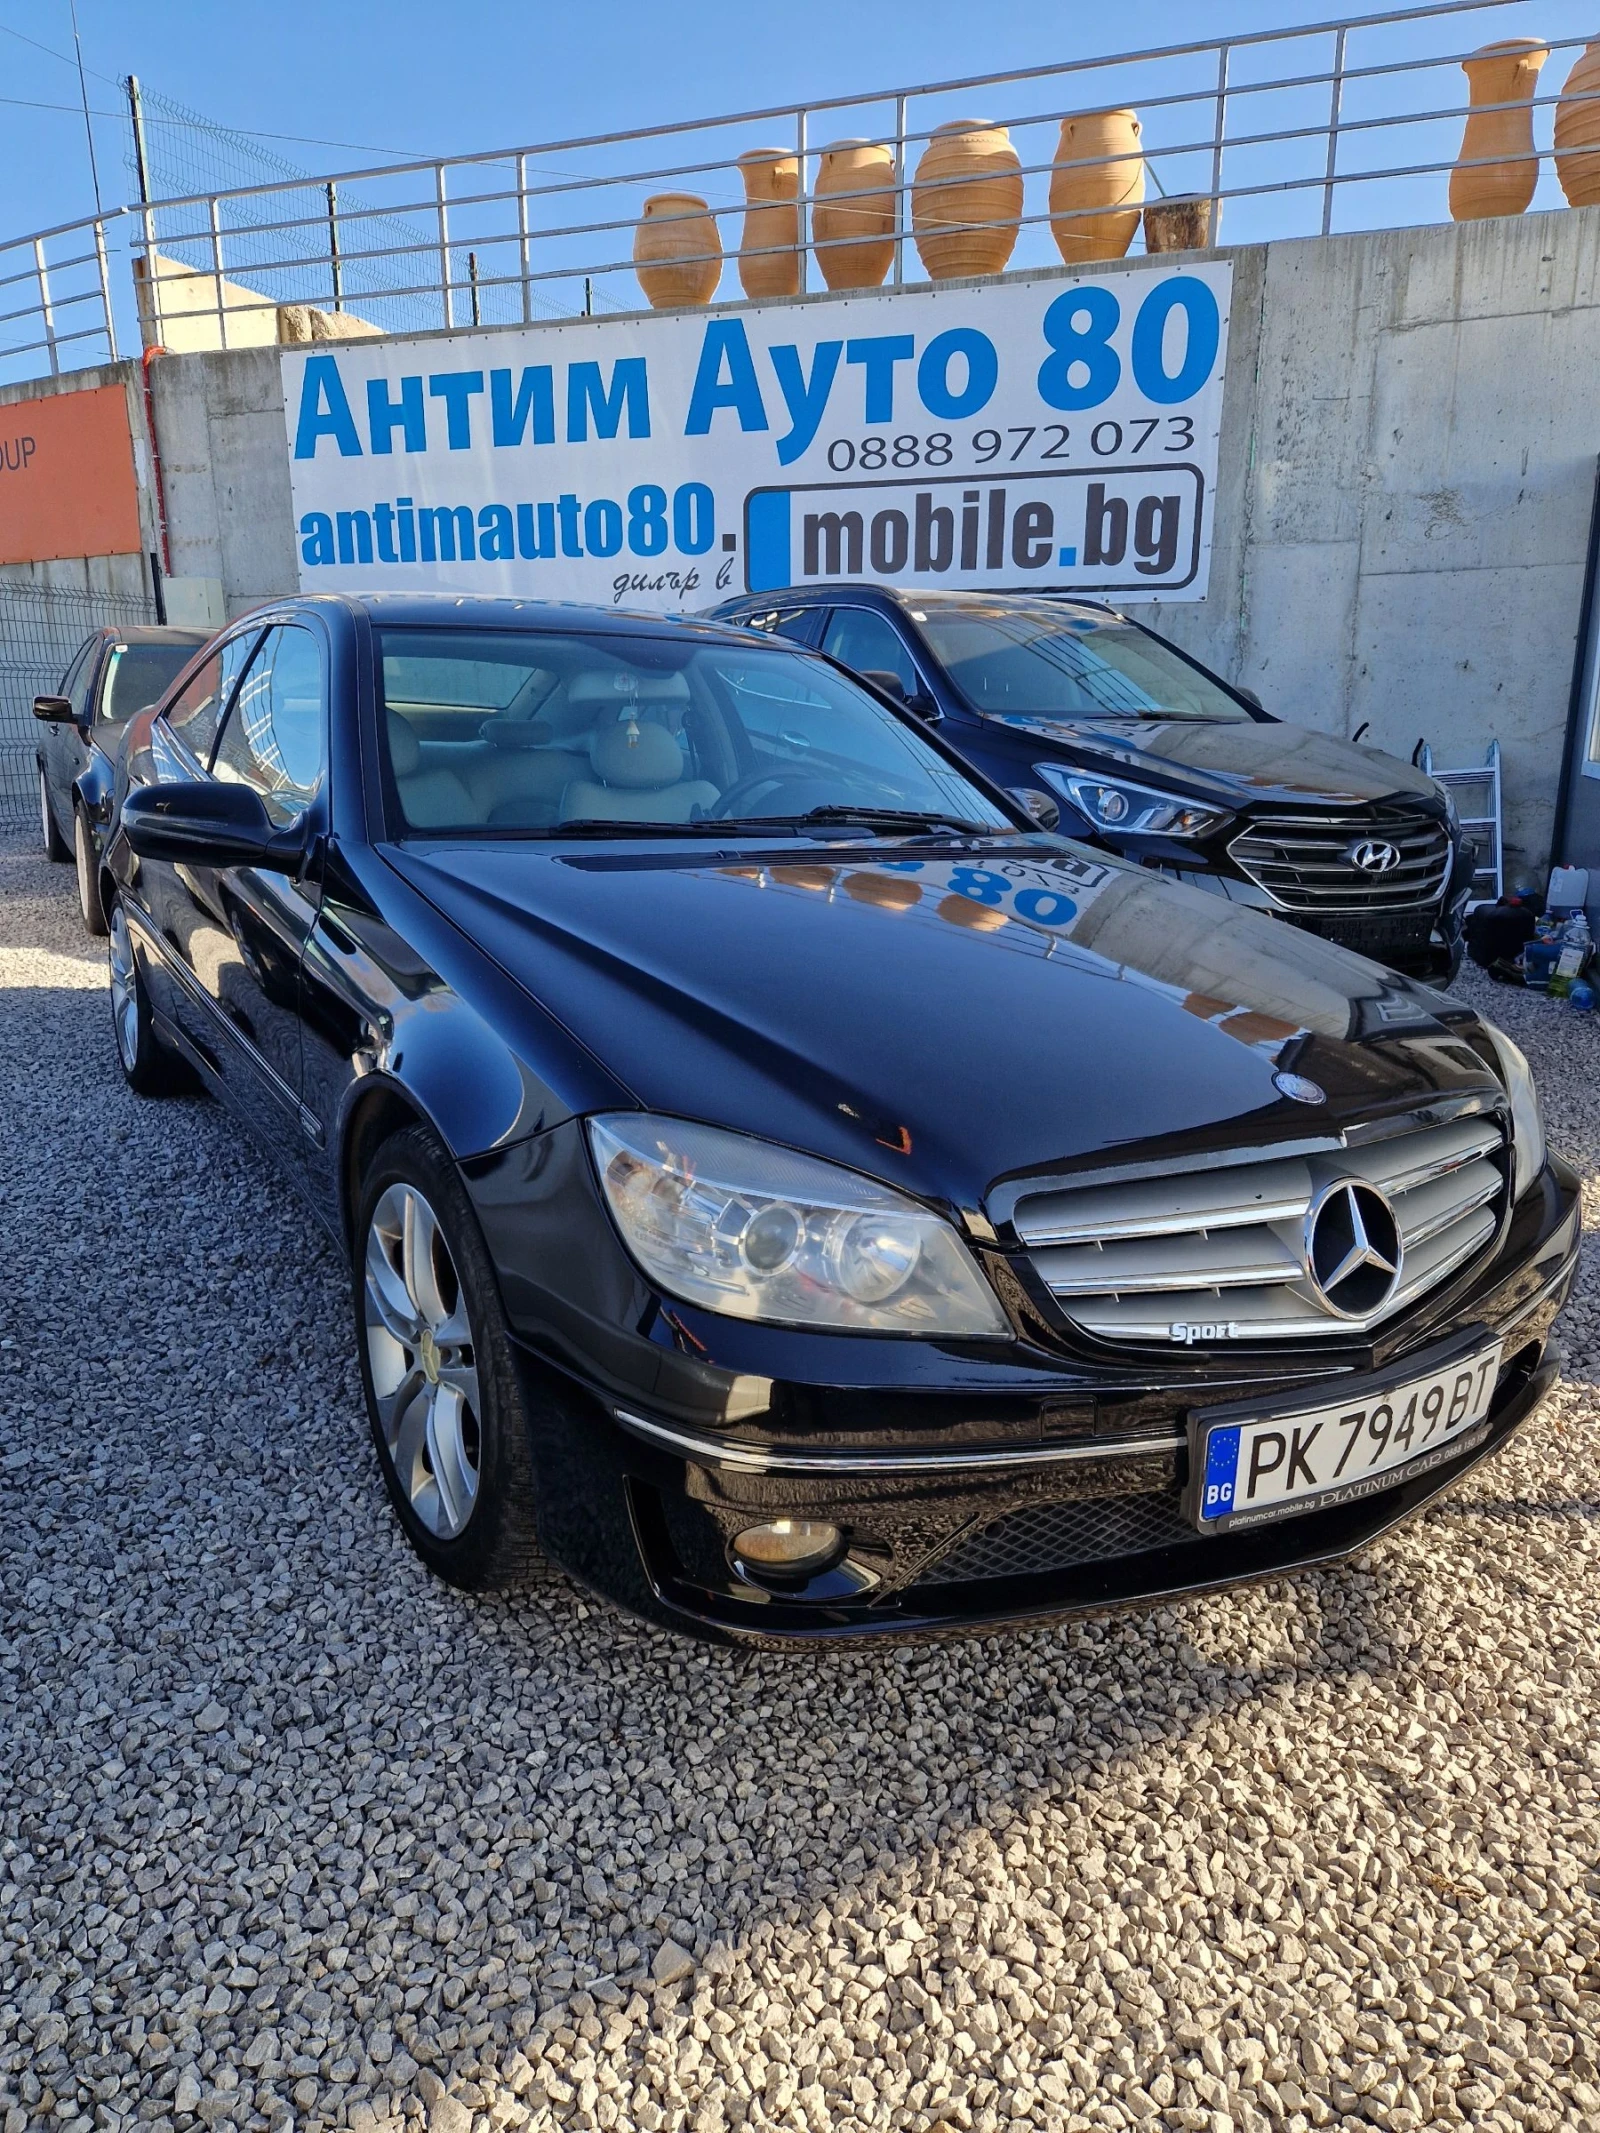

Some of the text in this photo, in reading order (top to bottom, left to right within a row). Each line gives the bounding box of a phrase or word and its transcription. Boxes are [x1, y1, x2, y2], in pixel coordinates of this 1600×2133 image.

[294, 276, 1220, 466] Антим Ауто 80
[0, 436, 36, 472] UP
[827, 416, 1195, 471] 0888 972 073
[803, 483, 1181, 575] mobile.bg
[613, 568, 701, 604] дилър
[1169, 1322, 1239, 1344] Sport
[1206, 1482, 1232, 1505] BG
[1228, 1500, 1316, 1528] platinumcar.mobile.bg
[1319, 1469, 1405, 1507] PLATINUM
[1406, 1453, 1442, 1477] CAR
